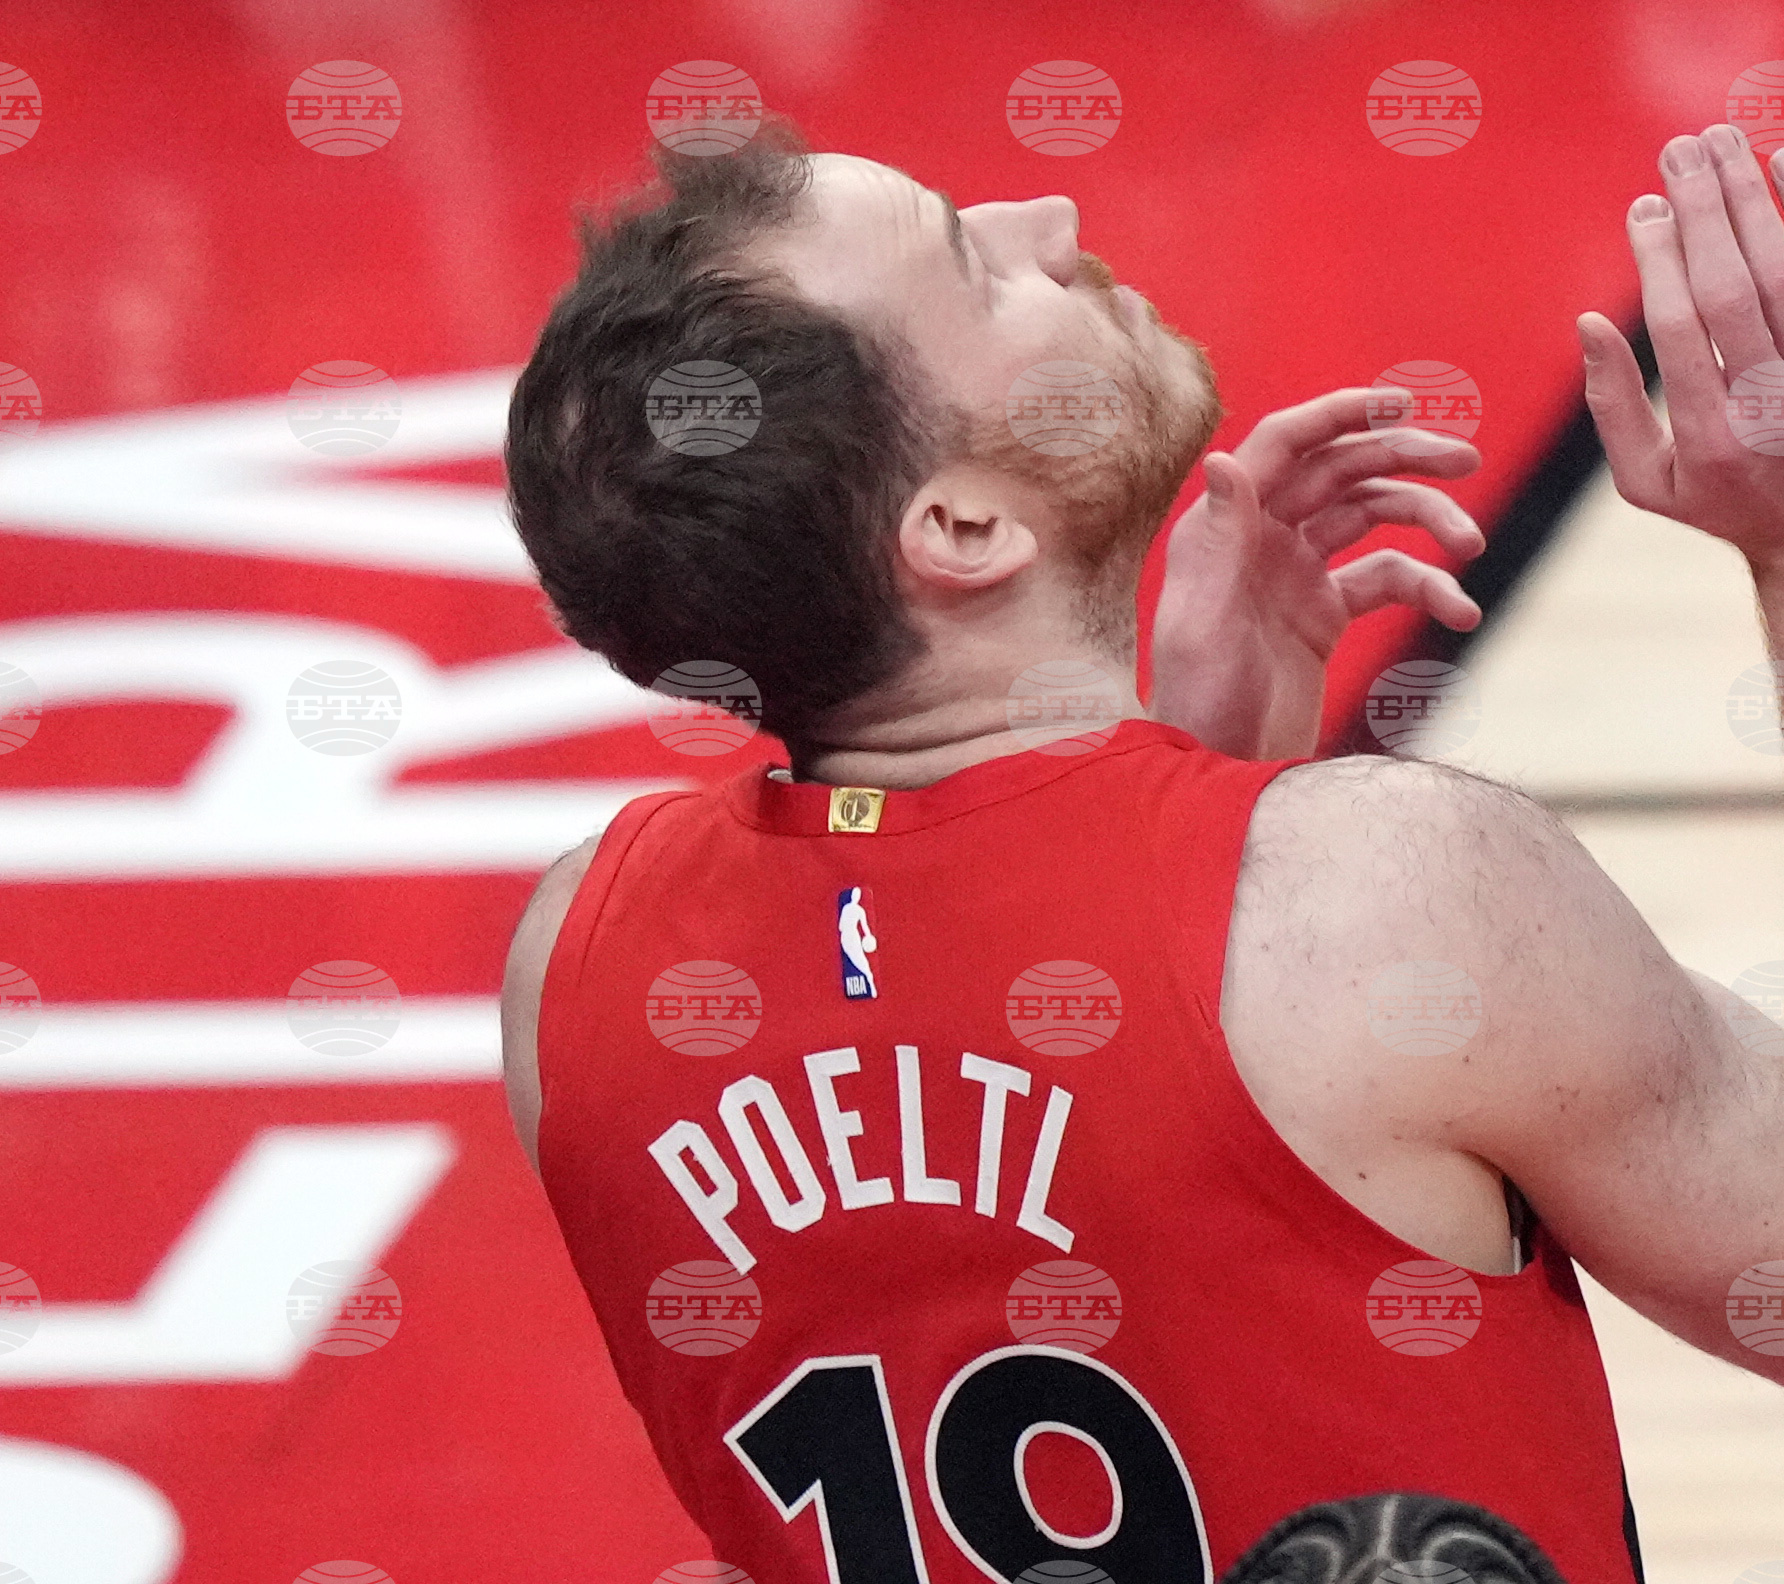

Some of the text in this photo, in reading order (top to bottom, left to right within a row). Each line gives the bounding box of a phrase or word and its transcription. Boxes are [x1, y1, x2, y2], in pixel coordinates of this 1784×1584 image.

[845, 975, 867, 996] NBA
[648, 1044, 1074, 1276] POELTL
[723, 1342, 1214, 1584] 19
